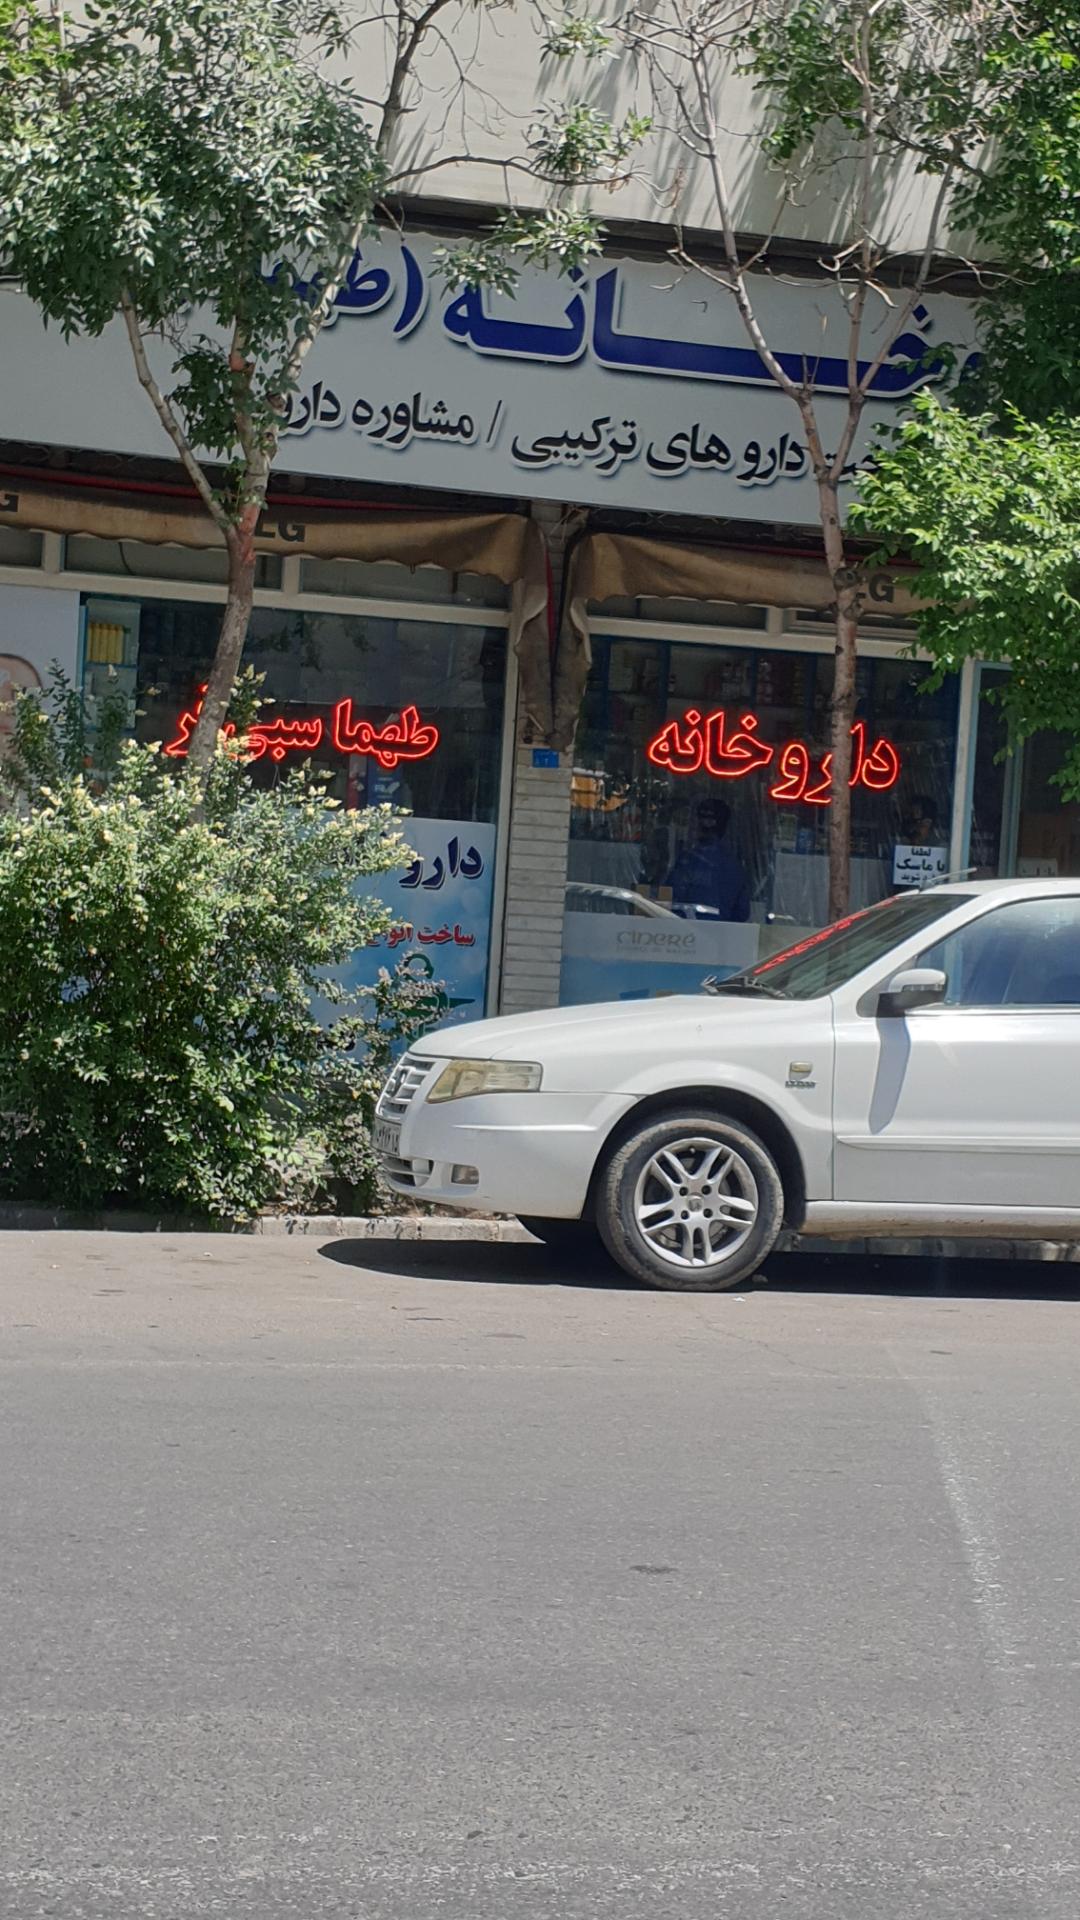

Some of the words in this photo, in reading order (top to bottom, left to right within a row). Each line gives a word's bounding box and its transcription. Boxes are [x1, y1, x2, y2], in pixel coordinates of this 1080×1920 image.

[352, 393, 474, 444] مشاوره
[512, 416, 637, 471] ترکیبی
[647, 424, 730, 473] های
[895, 858, 933, 872] ماسک
[417, 925, 475, 947] ساخت
